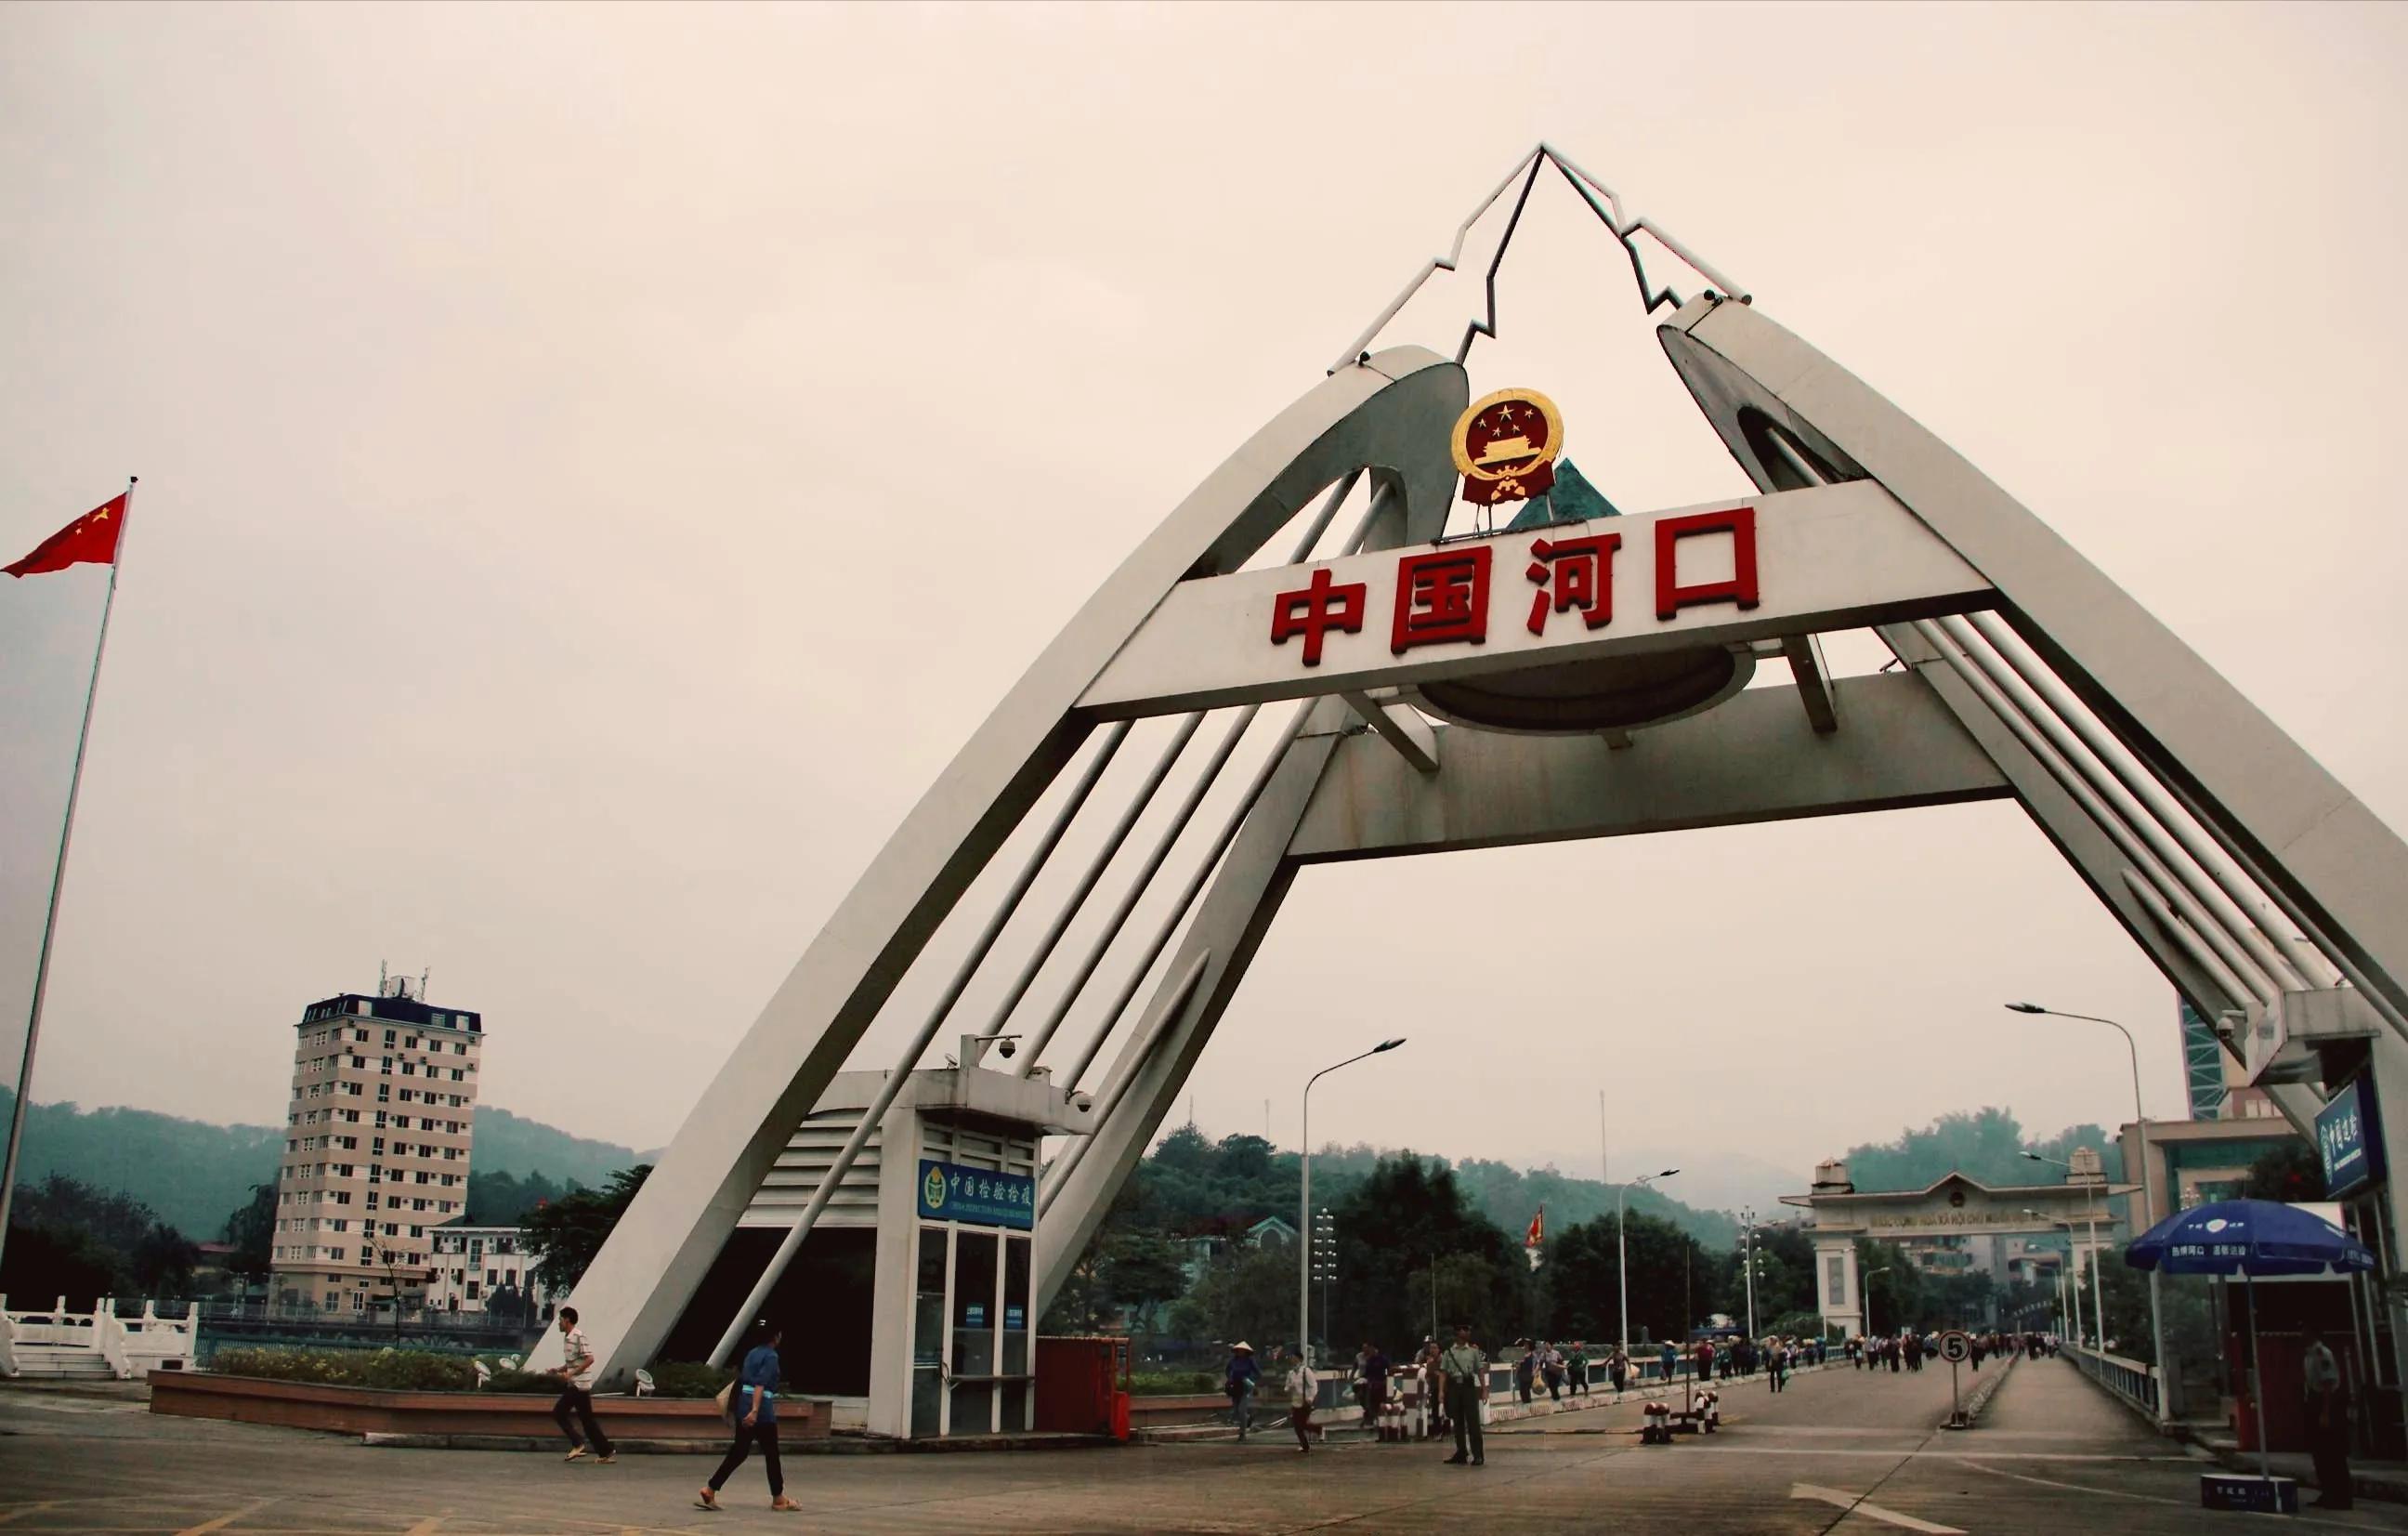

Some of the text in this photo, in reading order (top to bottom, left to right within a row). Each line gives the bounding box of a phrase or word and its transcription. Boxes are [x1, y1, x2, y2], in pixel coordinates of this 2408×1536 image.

[1270, 507, 1759, 666] 中国河口
[950, 1171, 1031, 1207] 中国检验检疫
[1948, 1337, 1963, 1359] 5
